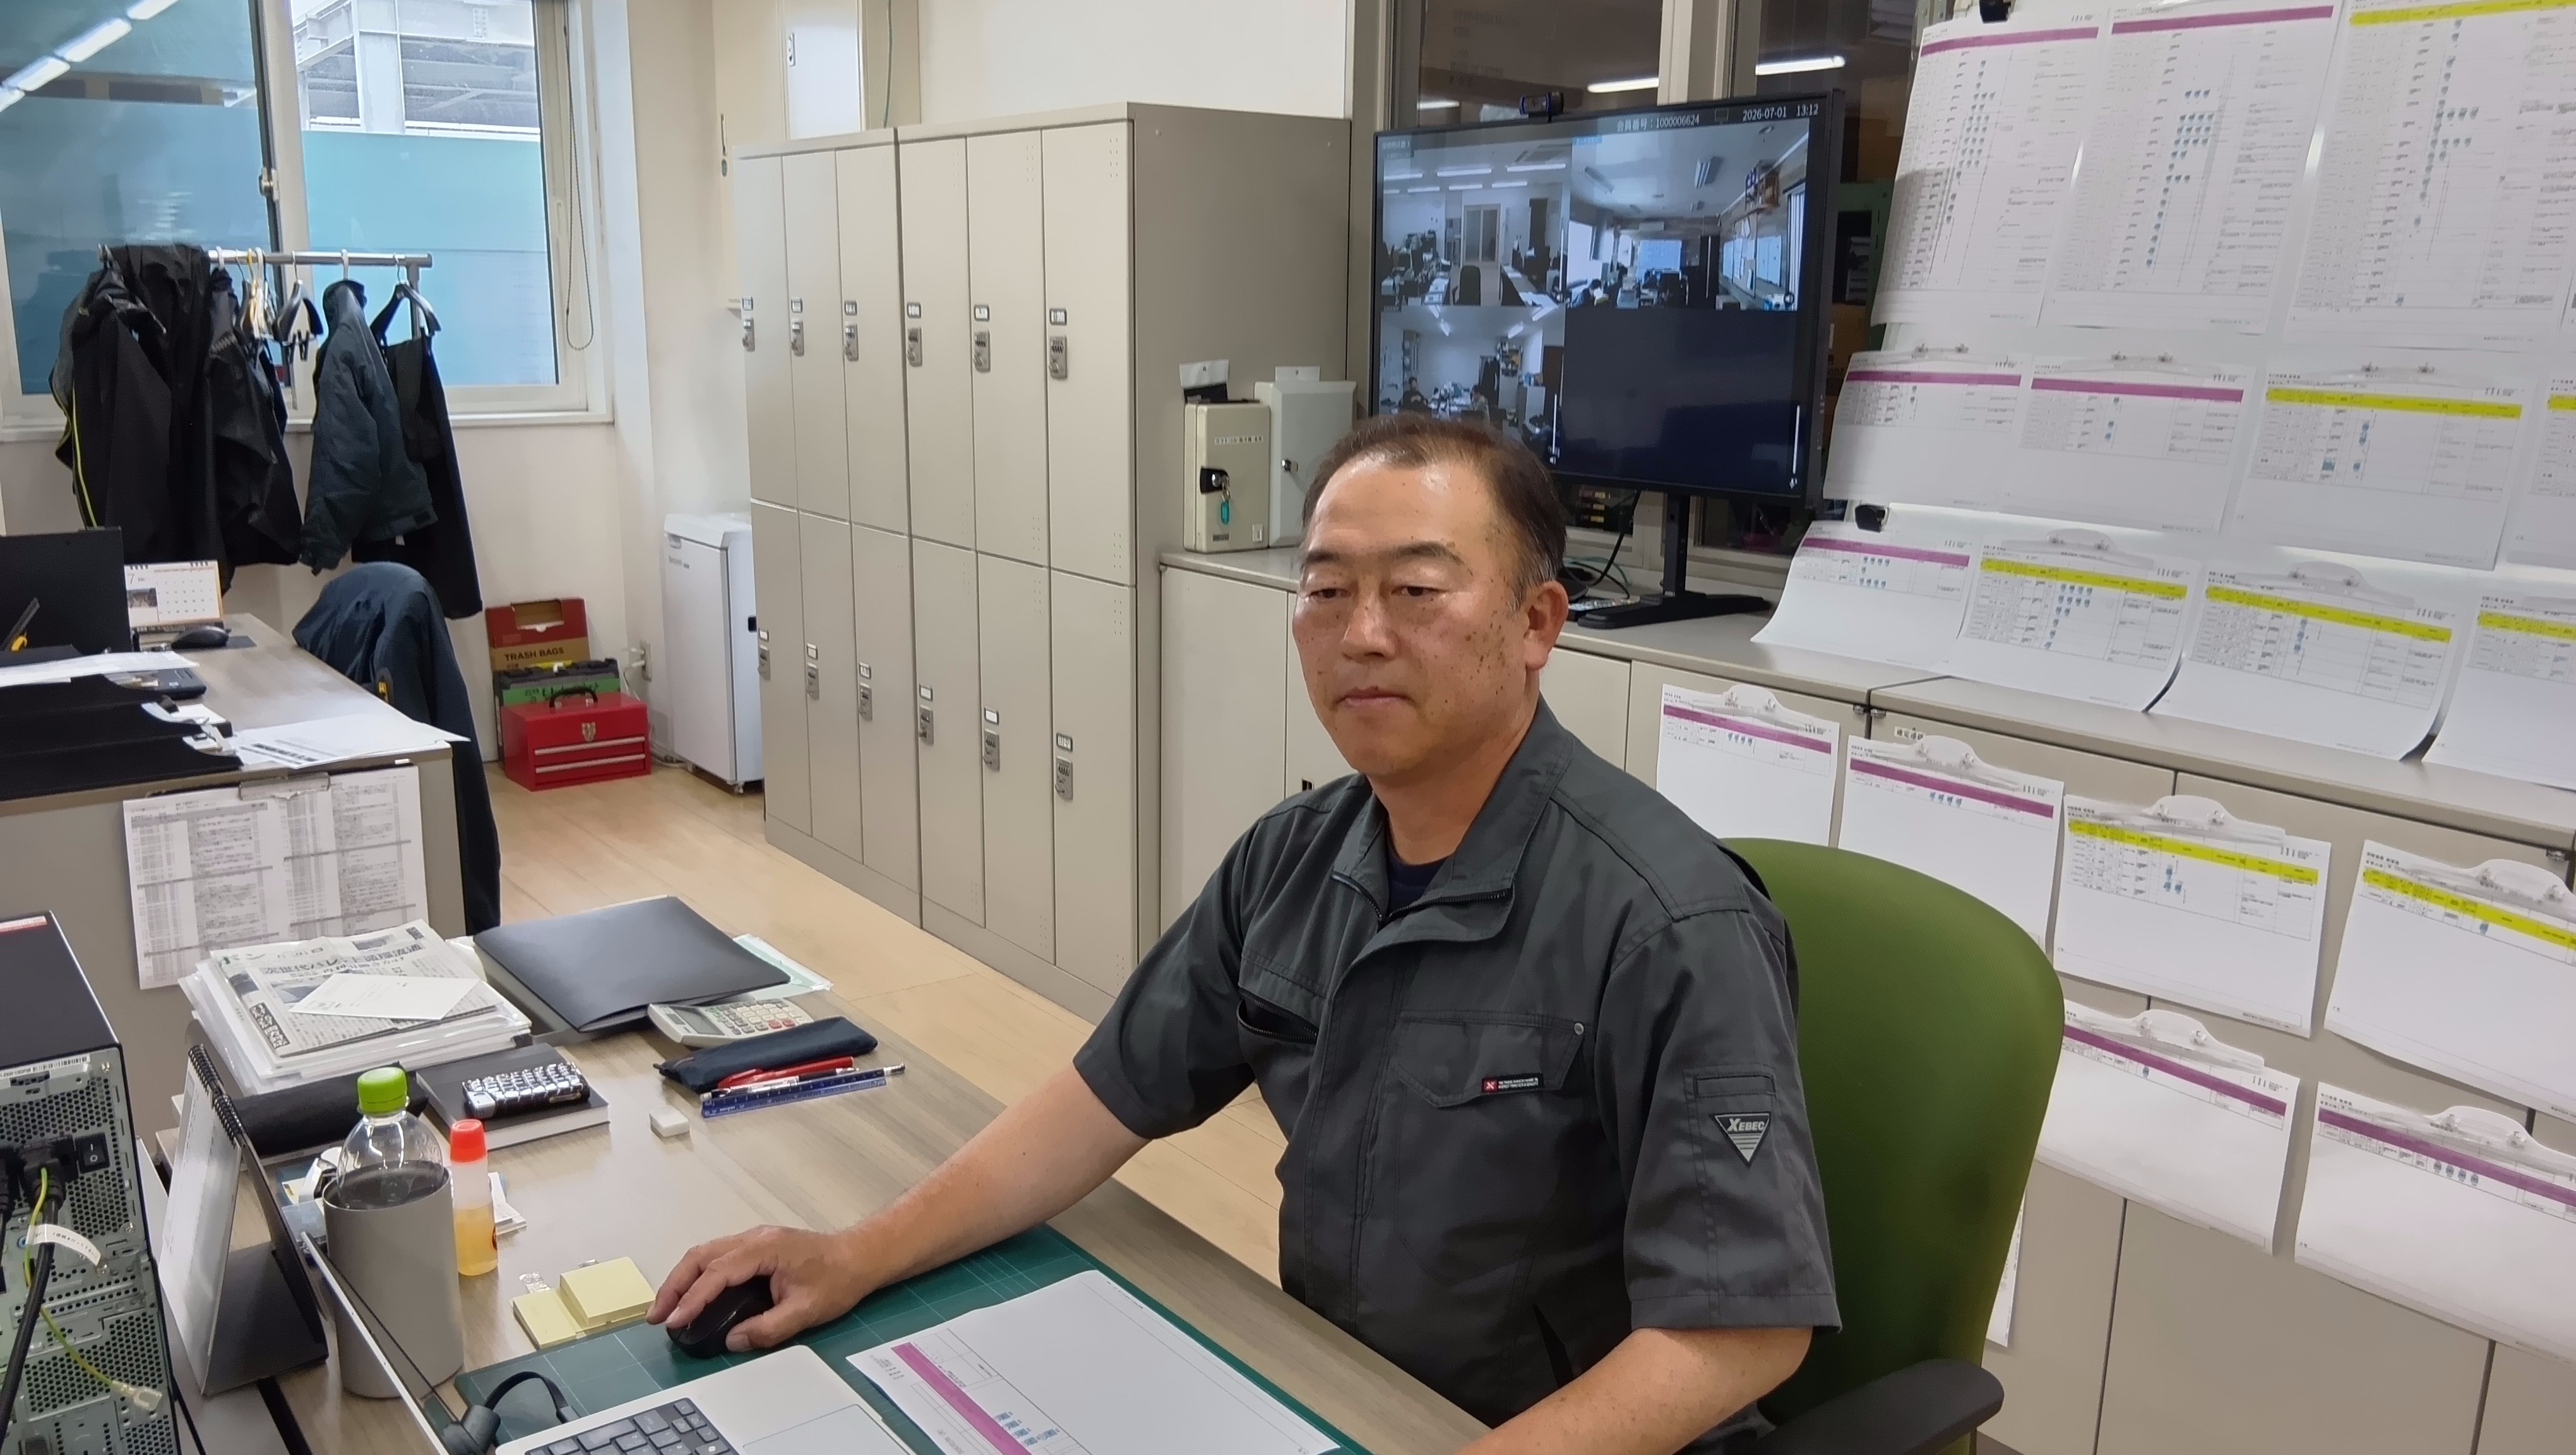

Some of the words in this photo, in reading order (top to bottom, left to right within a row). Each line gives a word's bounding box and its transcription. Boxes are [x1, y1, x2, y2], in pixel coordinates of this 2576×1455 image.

[1743, 105, 1787, 121] 2026-07-01
[1796, 104, 1819, 117] 13:12
[127, 573, 135, 585] 7
[504, 650, 537, 662] TRASH
[539, 646, 564, 657] BAGS
[1727, 1118, 1765, 1132] XEBEC
